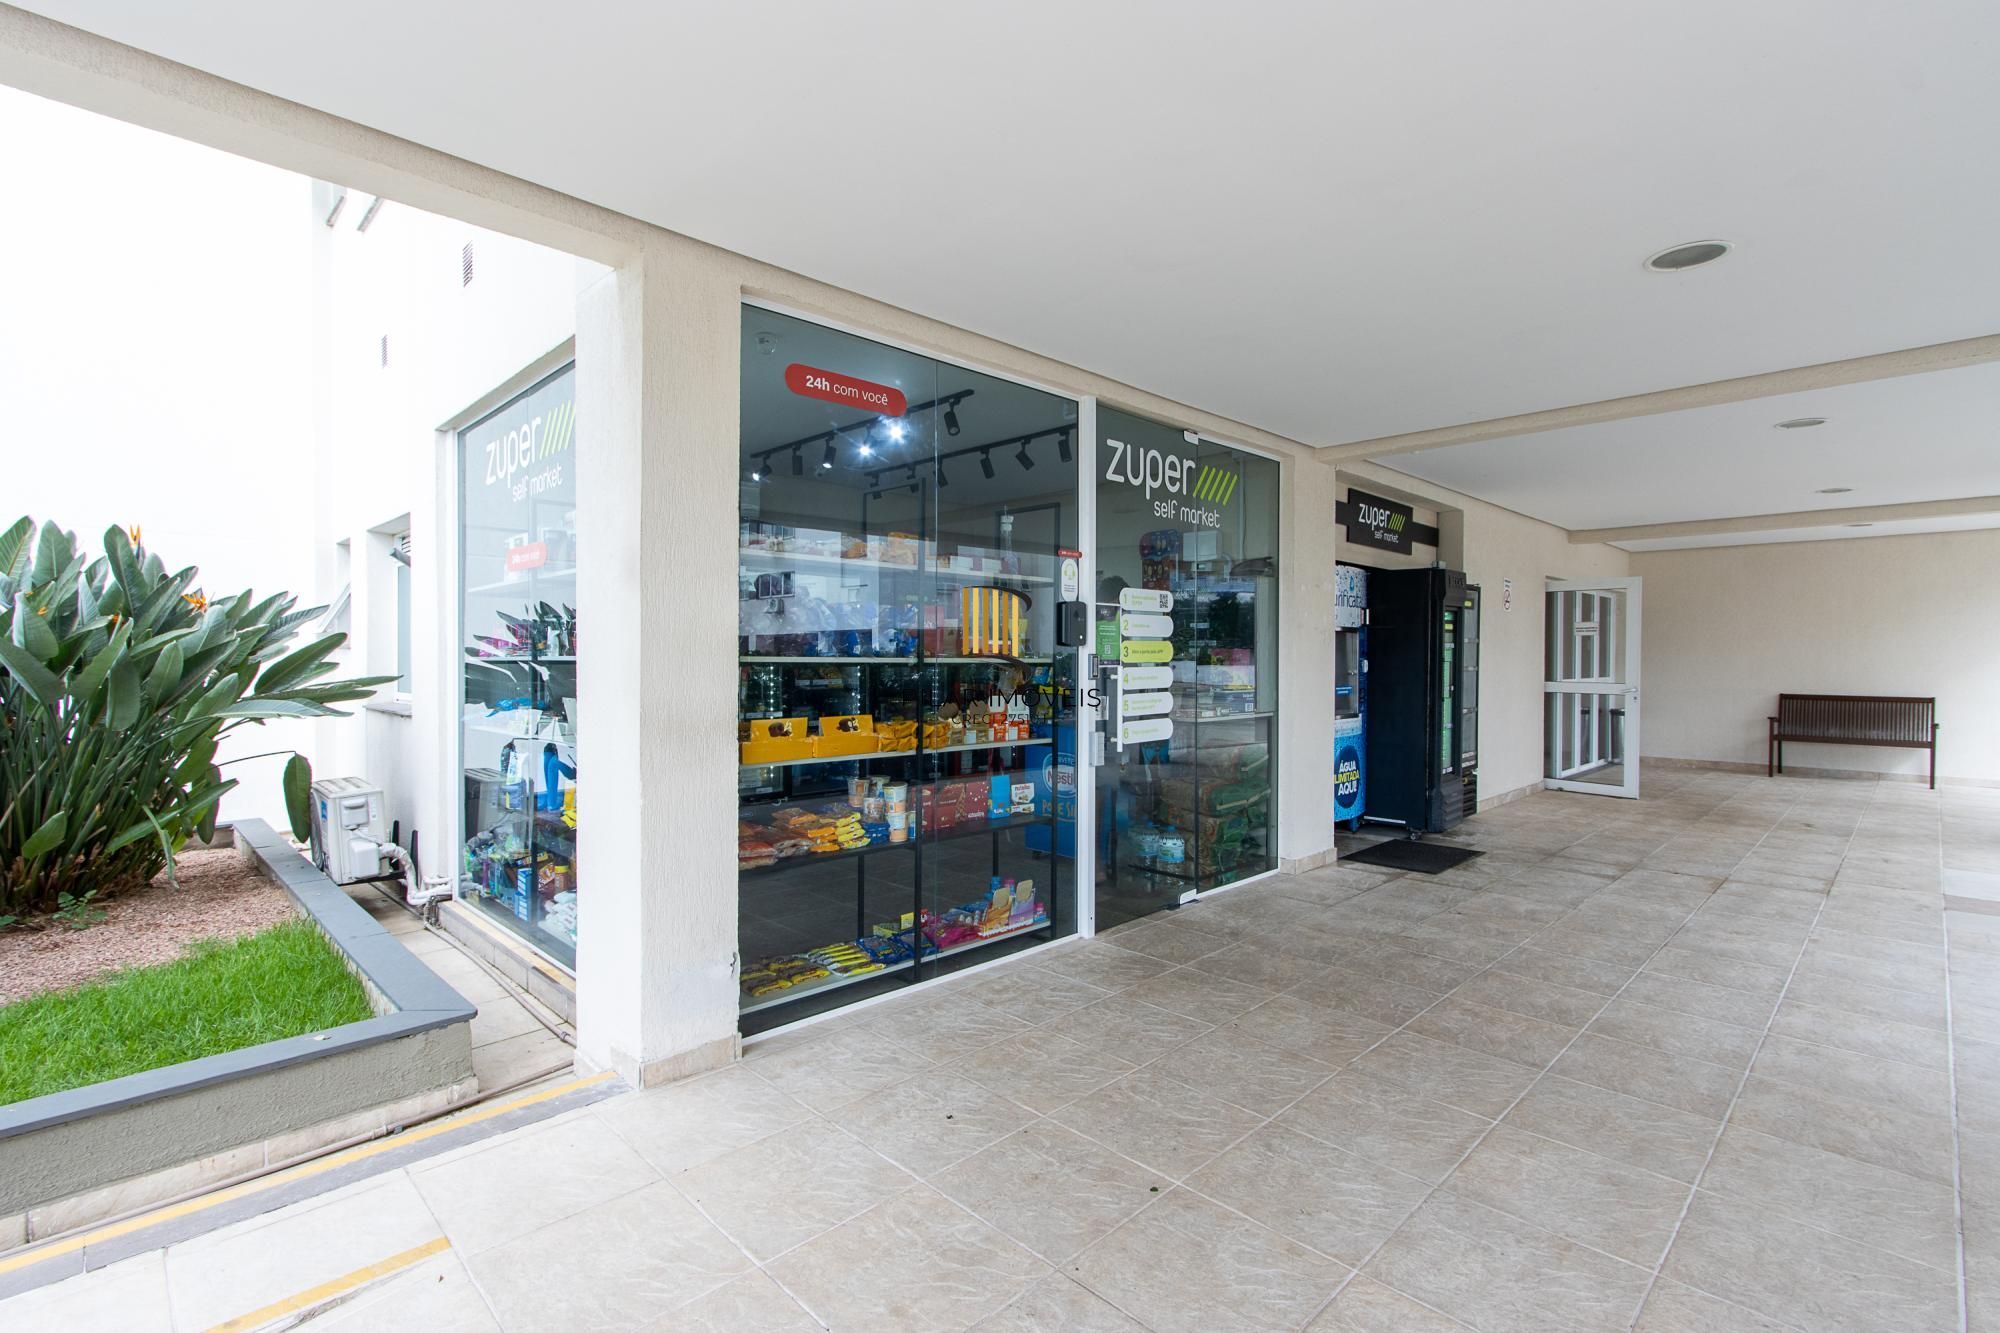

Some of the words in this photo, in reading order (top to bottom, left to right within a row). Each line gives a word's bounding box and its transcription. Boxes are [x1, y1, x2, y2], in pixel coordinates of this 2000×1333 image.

[805, 375, 830, 391] 24h
[833, 383, 859, 399] com
[862, 390, 888, 406] você
[486, 416, 541, 488] zuper
[512, 475, 528, 502] self
[530, 462, 562, 496] market
[1106, 438, 1196, 500] zuper
[1153, 499, 1178, 519] self
[1180, 507, 1220, 529] market
[1358, 503, 1390, 531] zuper
[1123, 619, 1129, 631] 2
[1123, 646, 1129, 658] 3
